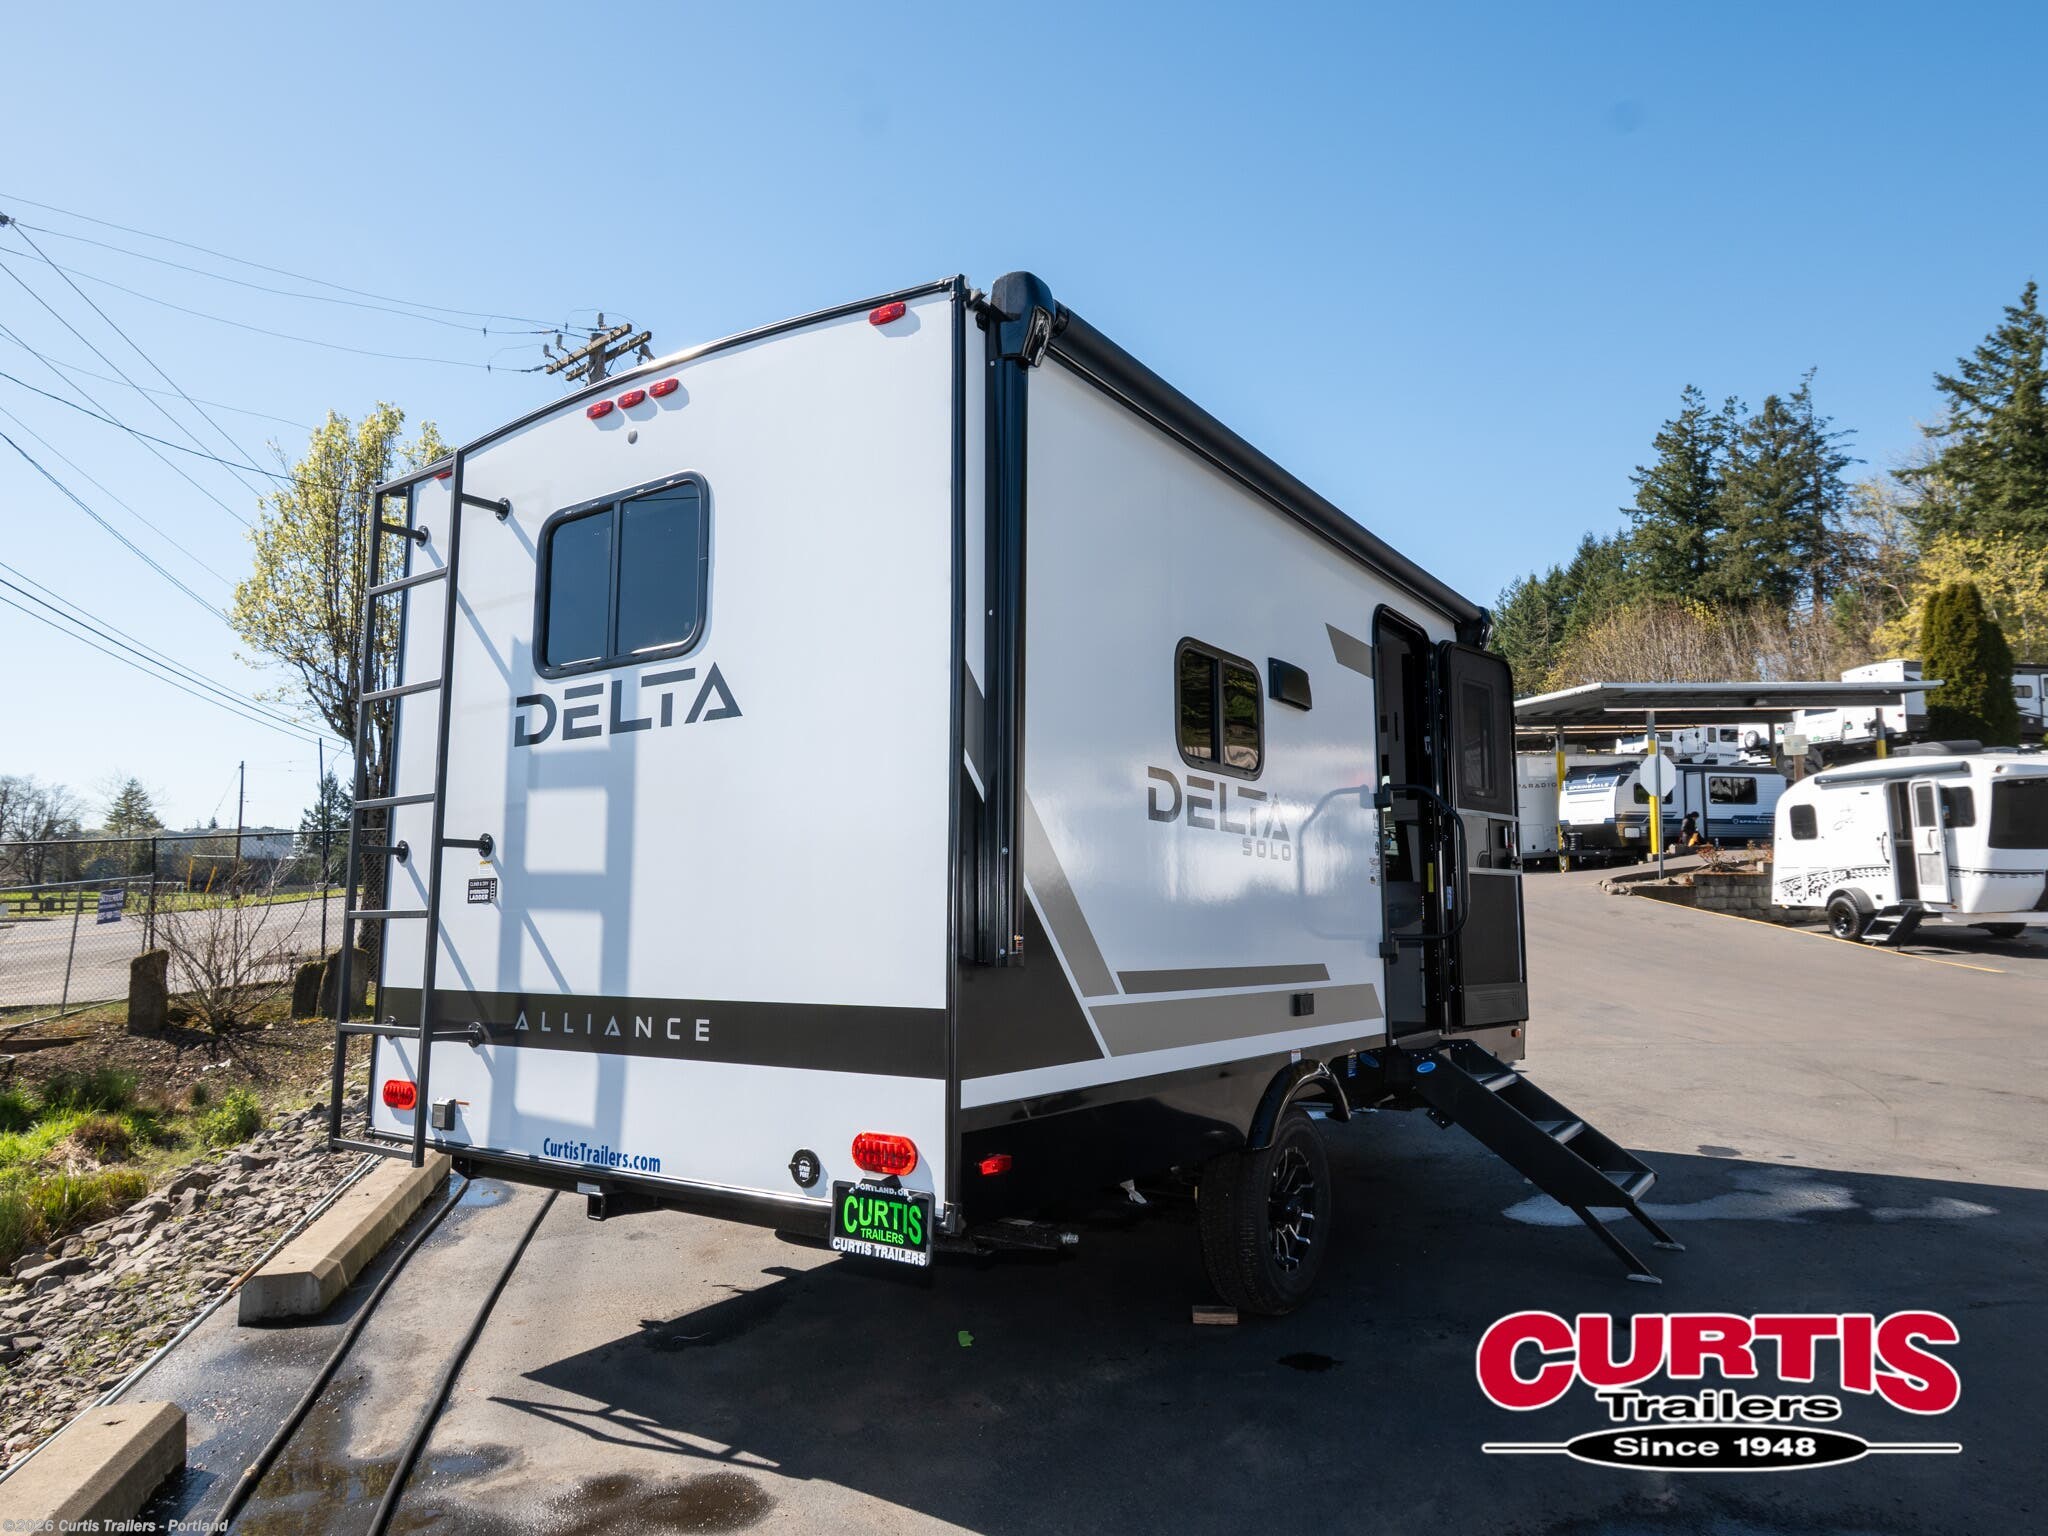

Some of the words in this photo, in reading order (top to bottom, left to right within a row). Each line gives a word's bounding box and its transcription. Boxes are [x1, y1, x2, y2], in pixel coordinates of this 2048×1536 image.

[514, 661, 743, 748] DELTA
[1148, 766, 1290, 842] DELTA
[1243, 837, 1291, 861] SOLO
[515, 1011, 710, 1042] ALLIANCE
[543, 1138, 661, 1173] CurtisTrailers.com
[844, 1195, 922, 1245] CURTIS
[861, 1228, 904, 1245] TRAILERS
[833, 1238, 872, 1256] CURTIS
[874, 1245, 926, 1267] TRAILERS
